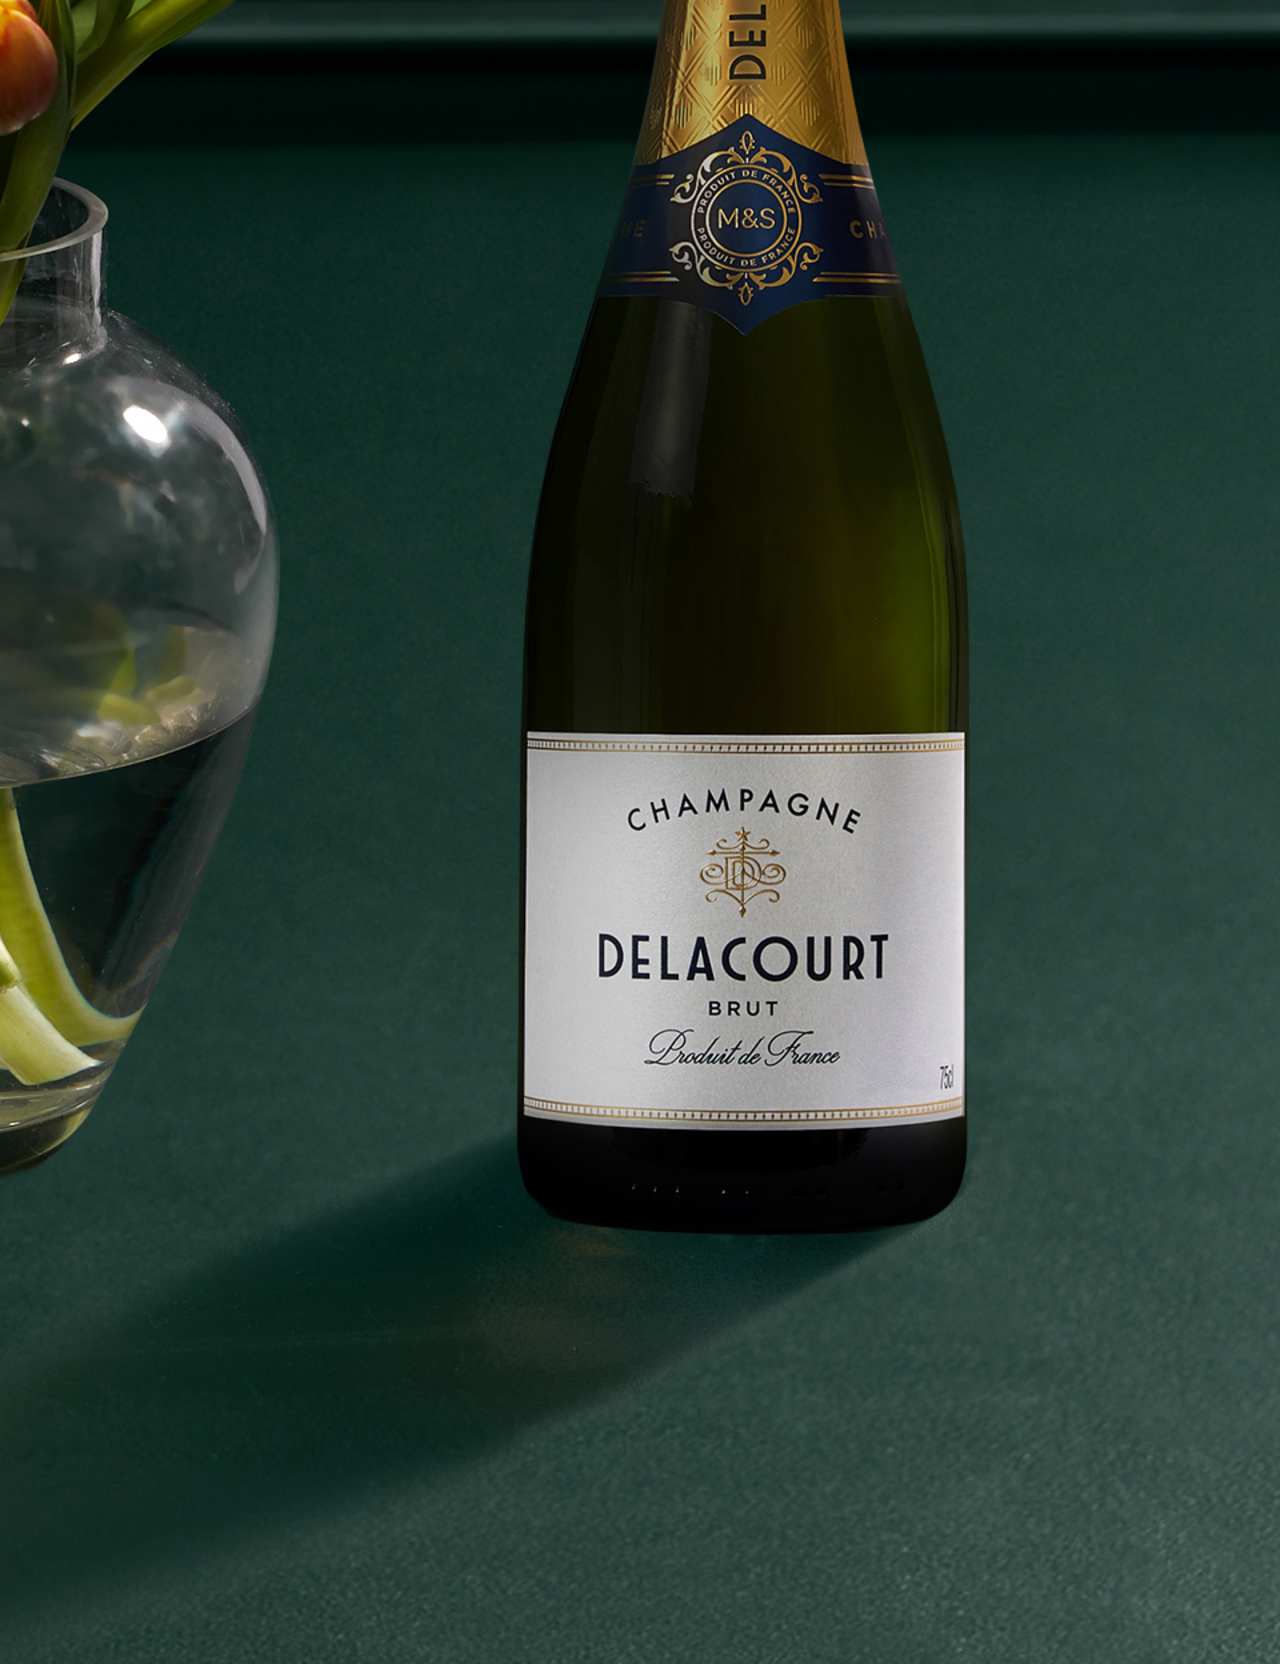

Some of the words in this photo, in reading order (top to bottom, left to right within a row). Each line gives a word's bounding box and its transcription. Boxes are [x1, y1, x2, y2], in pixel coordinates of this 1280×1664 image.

[697, 171, 736, 215] PRODUIT
[741, 169, 759, 179] DE
[761, 173, 797, 213] FRANCE
[717, 207, 776, 230] M&S
[697, 227, 736, 265] PRODUIT
[740, 258, 758, 267] DE
[626, 787, 862, 835] CHAMPAGNE
[597, 933, 889, 982] DELACOURT
[708, 1000, 779, 1017] BRUT
[643, 1028, 743, 1065] Produit
[737, 1035, 765, 1065] de
[764, 1030, 841, 1066] France
[939, 1063, 955, 1090] 75cl
